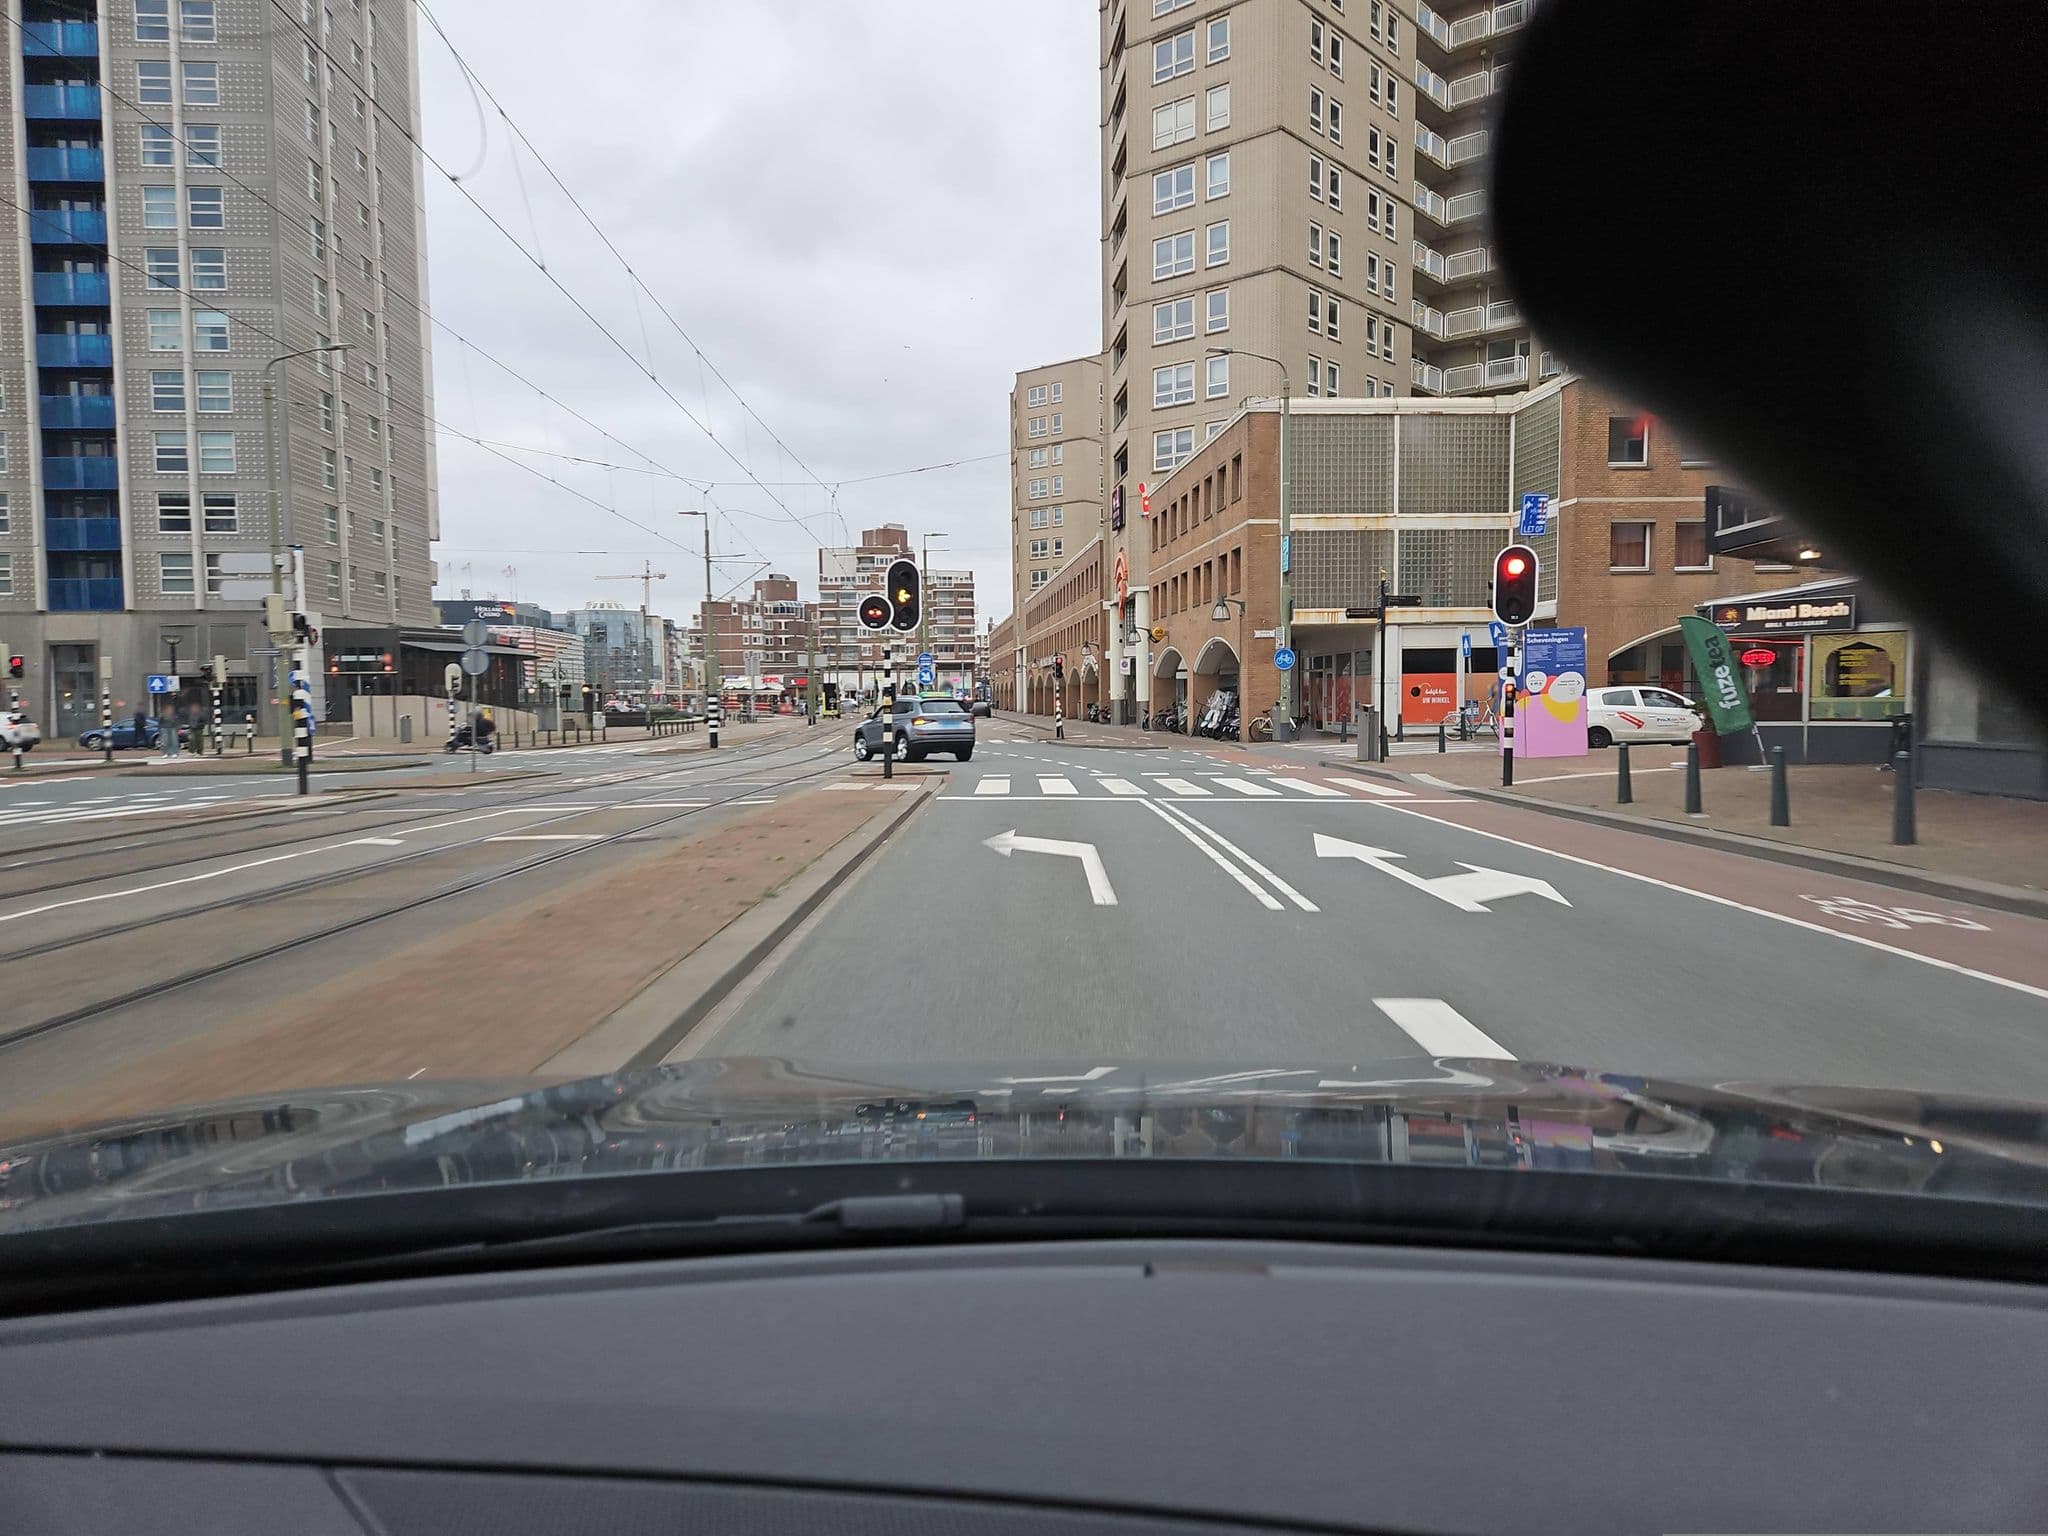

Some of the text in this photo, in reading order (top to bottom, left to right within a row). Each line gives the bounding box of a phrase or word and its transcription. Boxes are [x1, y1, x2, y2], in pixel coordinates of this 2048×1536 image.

[1746, 602, 1850, 621] Miami Beach
[1526, 636, 1569, 644] Scheveningen
